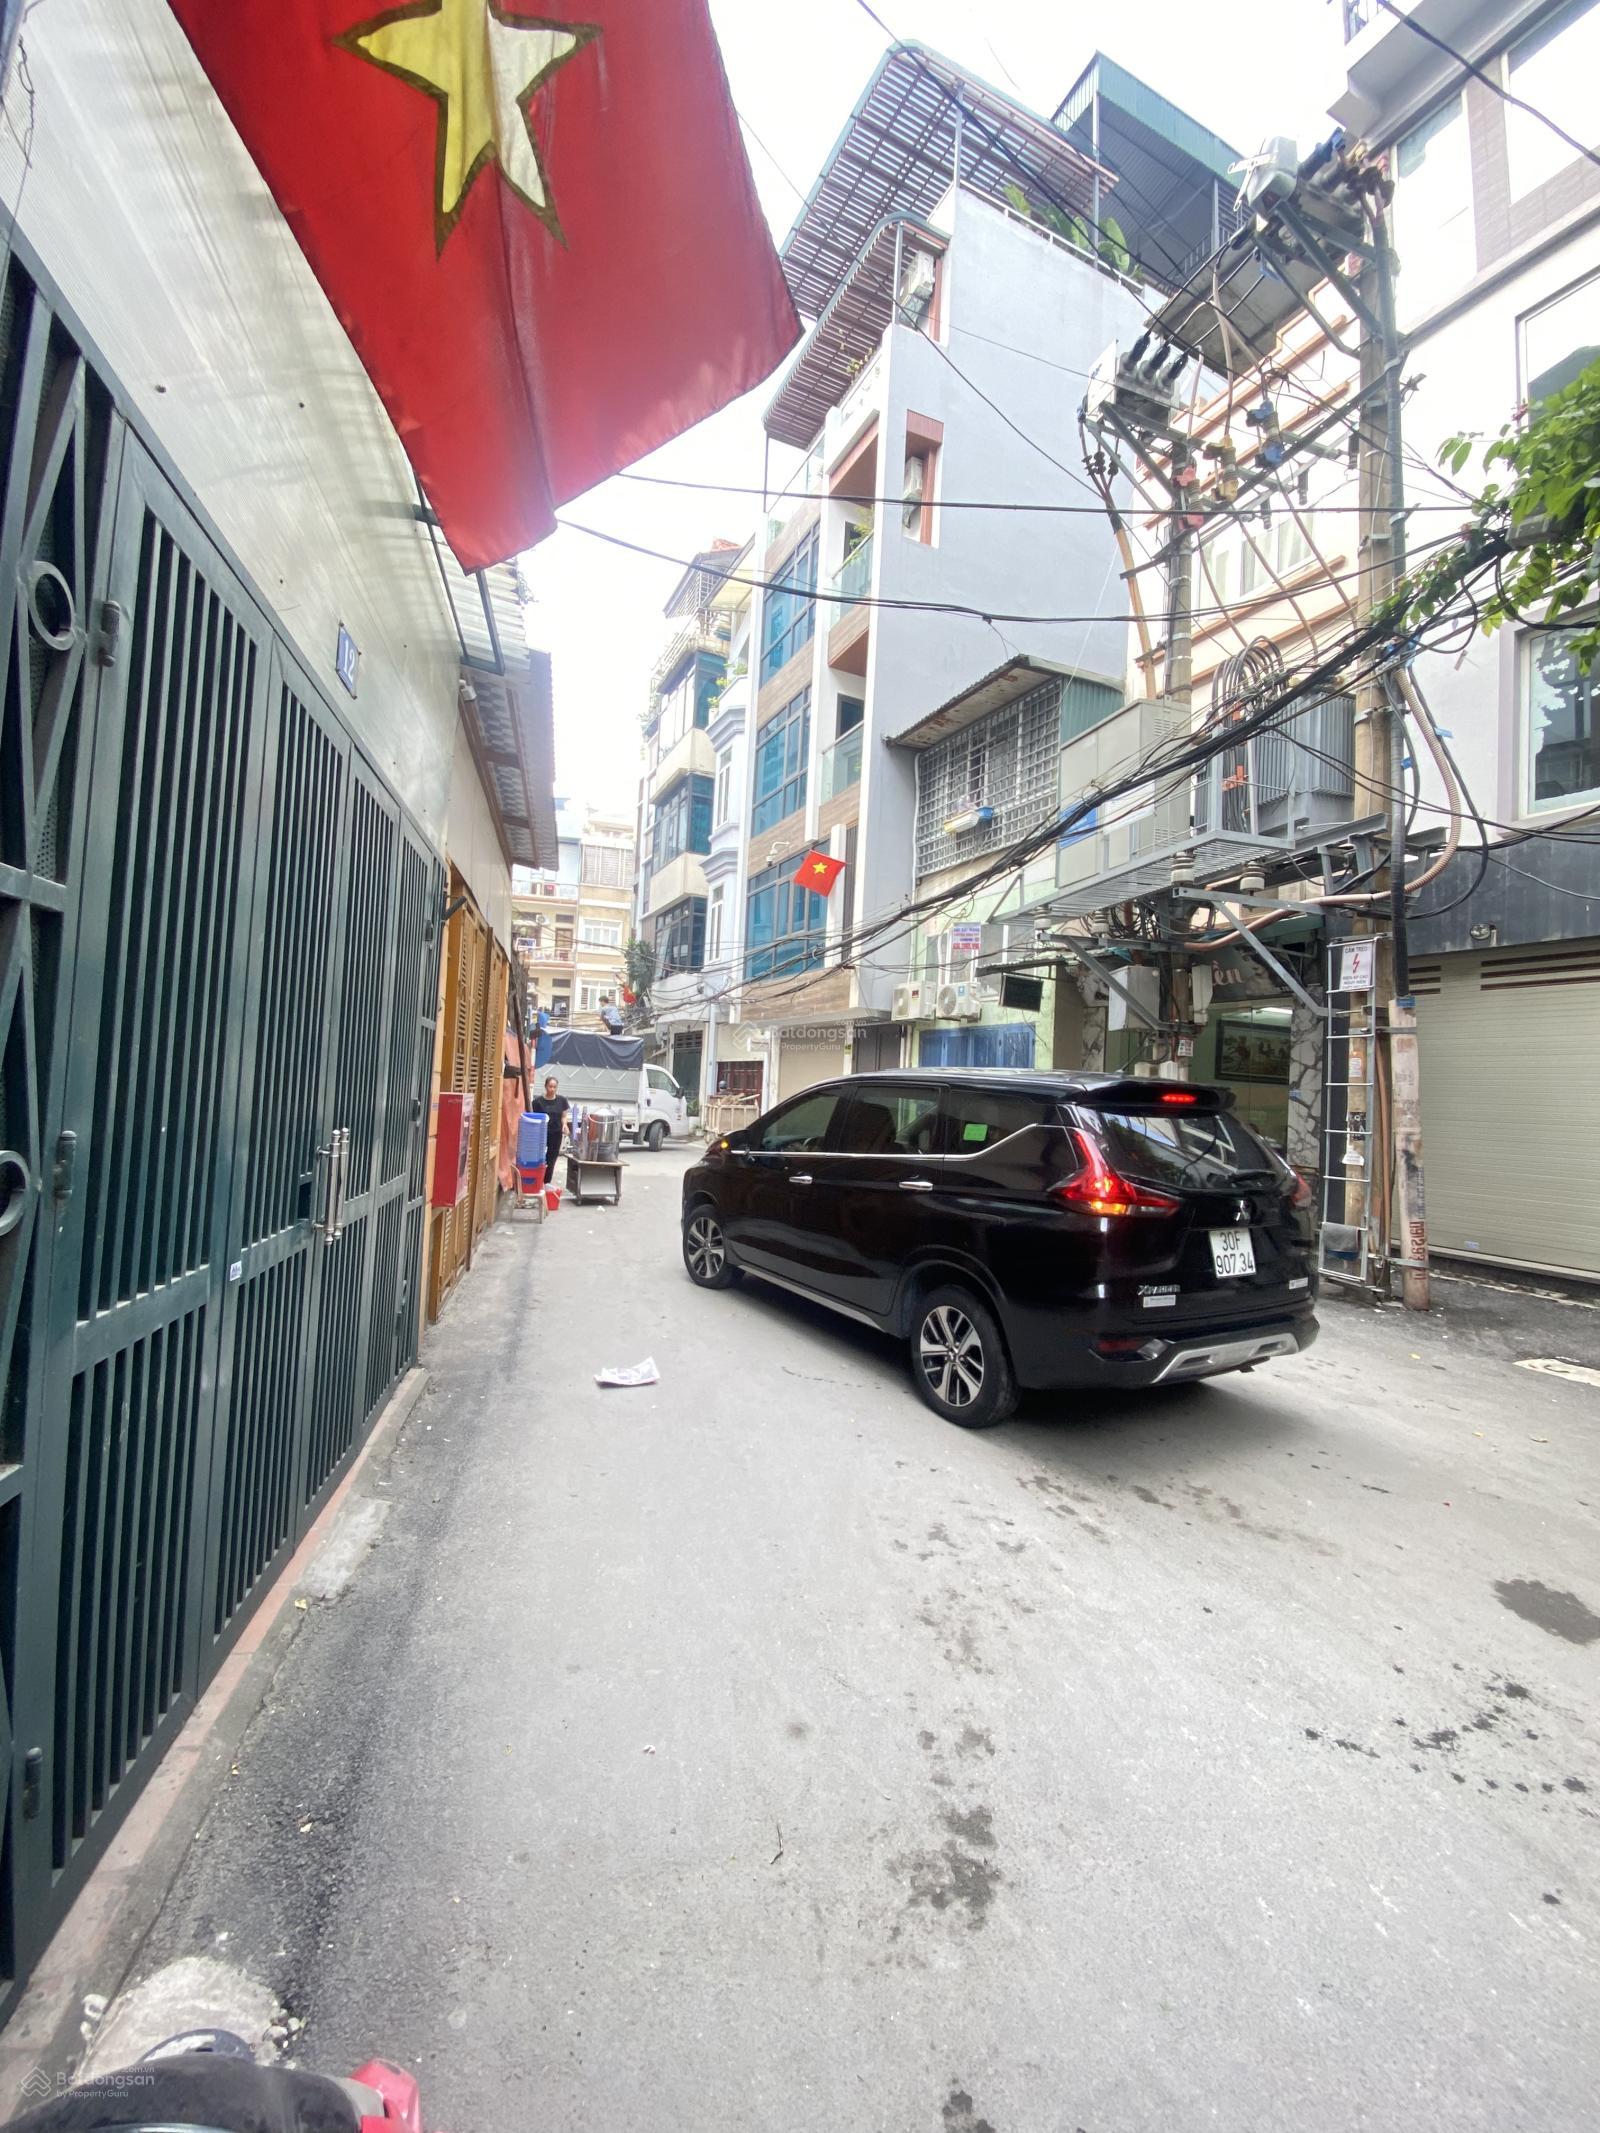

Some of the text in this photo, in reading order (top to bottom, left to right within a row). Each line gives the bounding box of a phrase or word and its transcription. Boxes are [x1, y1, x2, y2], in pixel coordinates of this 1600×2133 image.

[343, 638, 355, 685] 12
[1219, 1230, 1241, 1252] 30F
[1215, 1251, 1254, 1275] 907.34
